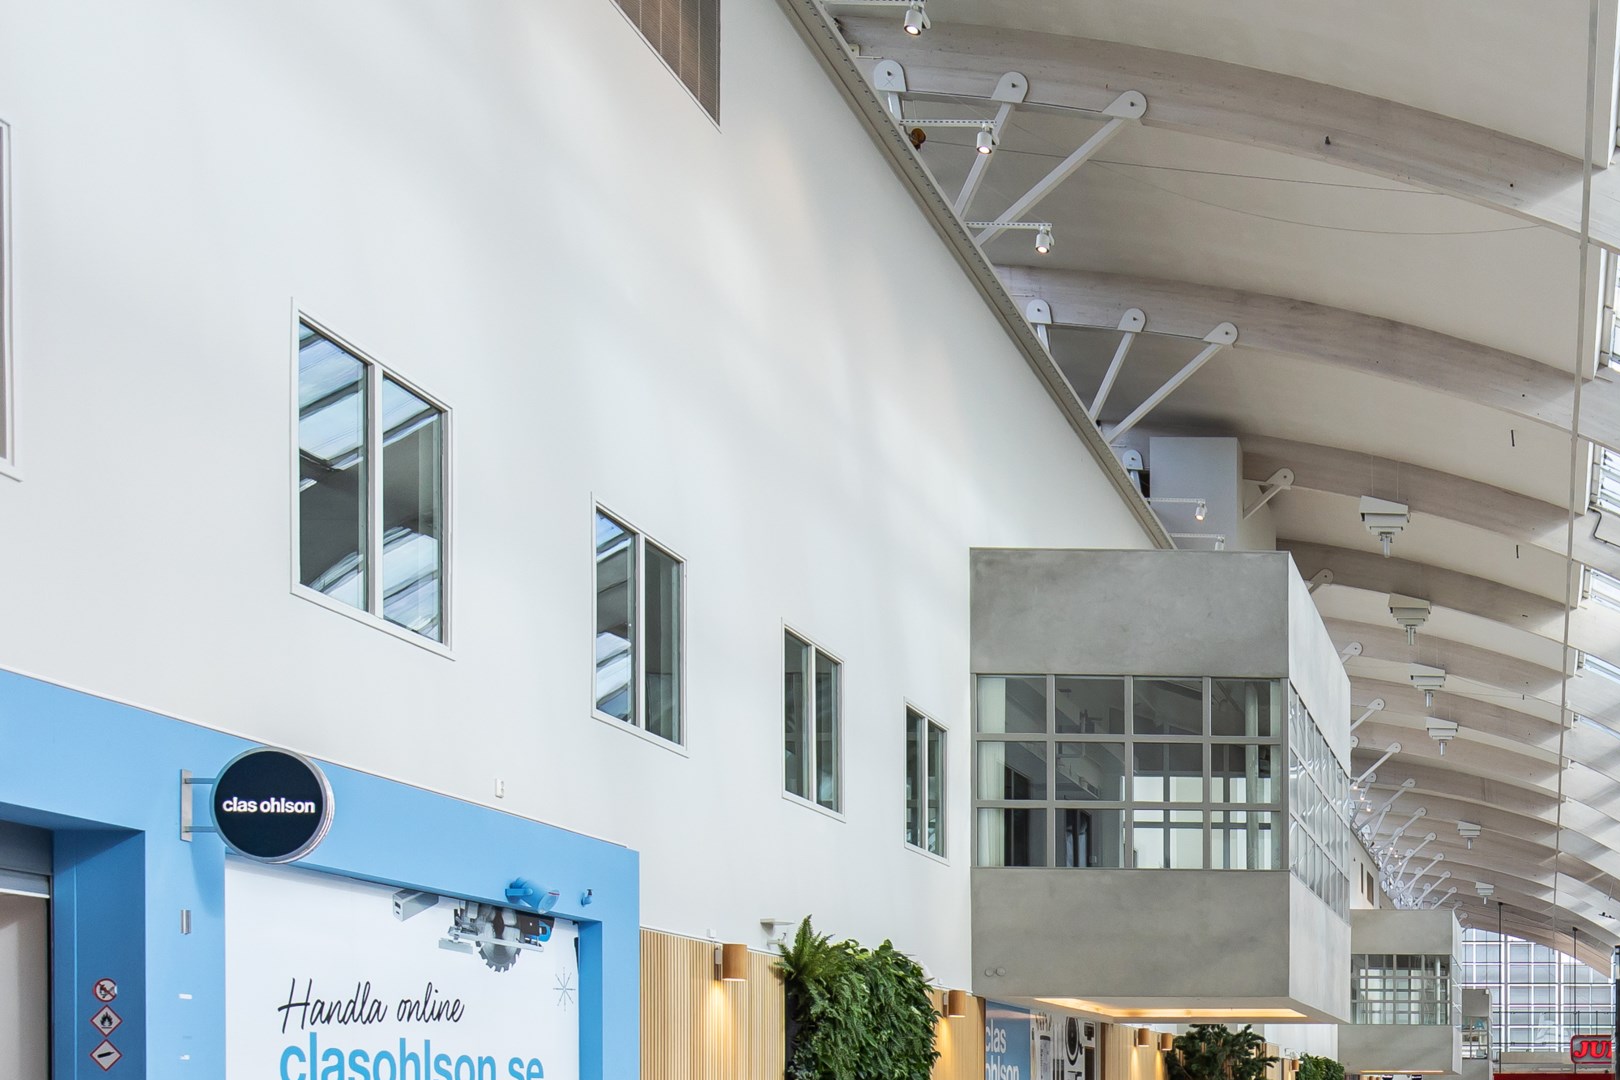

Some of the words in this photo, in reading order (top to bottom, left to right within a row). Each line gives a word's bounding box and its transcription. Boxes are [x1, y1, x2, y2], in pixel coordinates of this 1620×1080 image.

[222, 796, 258, 813] clas
[259, 797, 316, 814] ohlson
[277, 977, 388, 1034] Handla
[397, 981, 465, 1023] online
